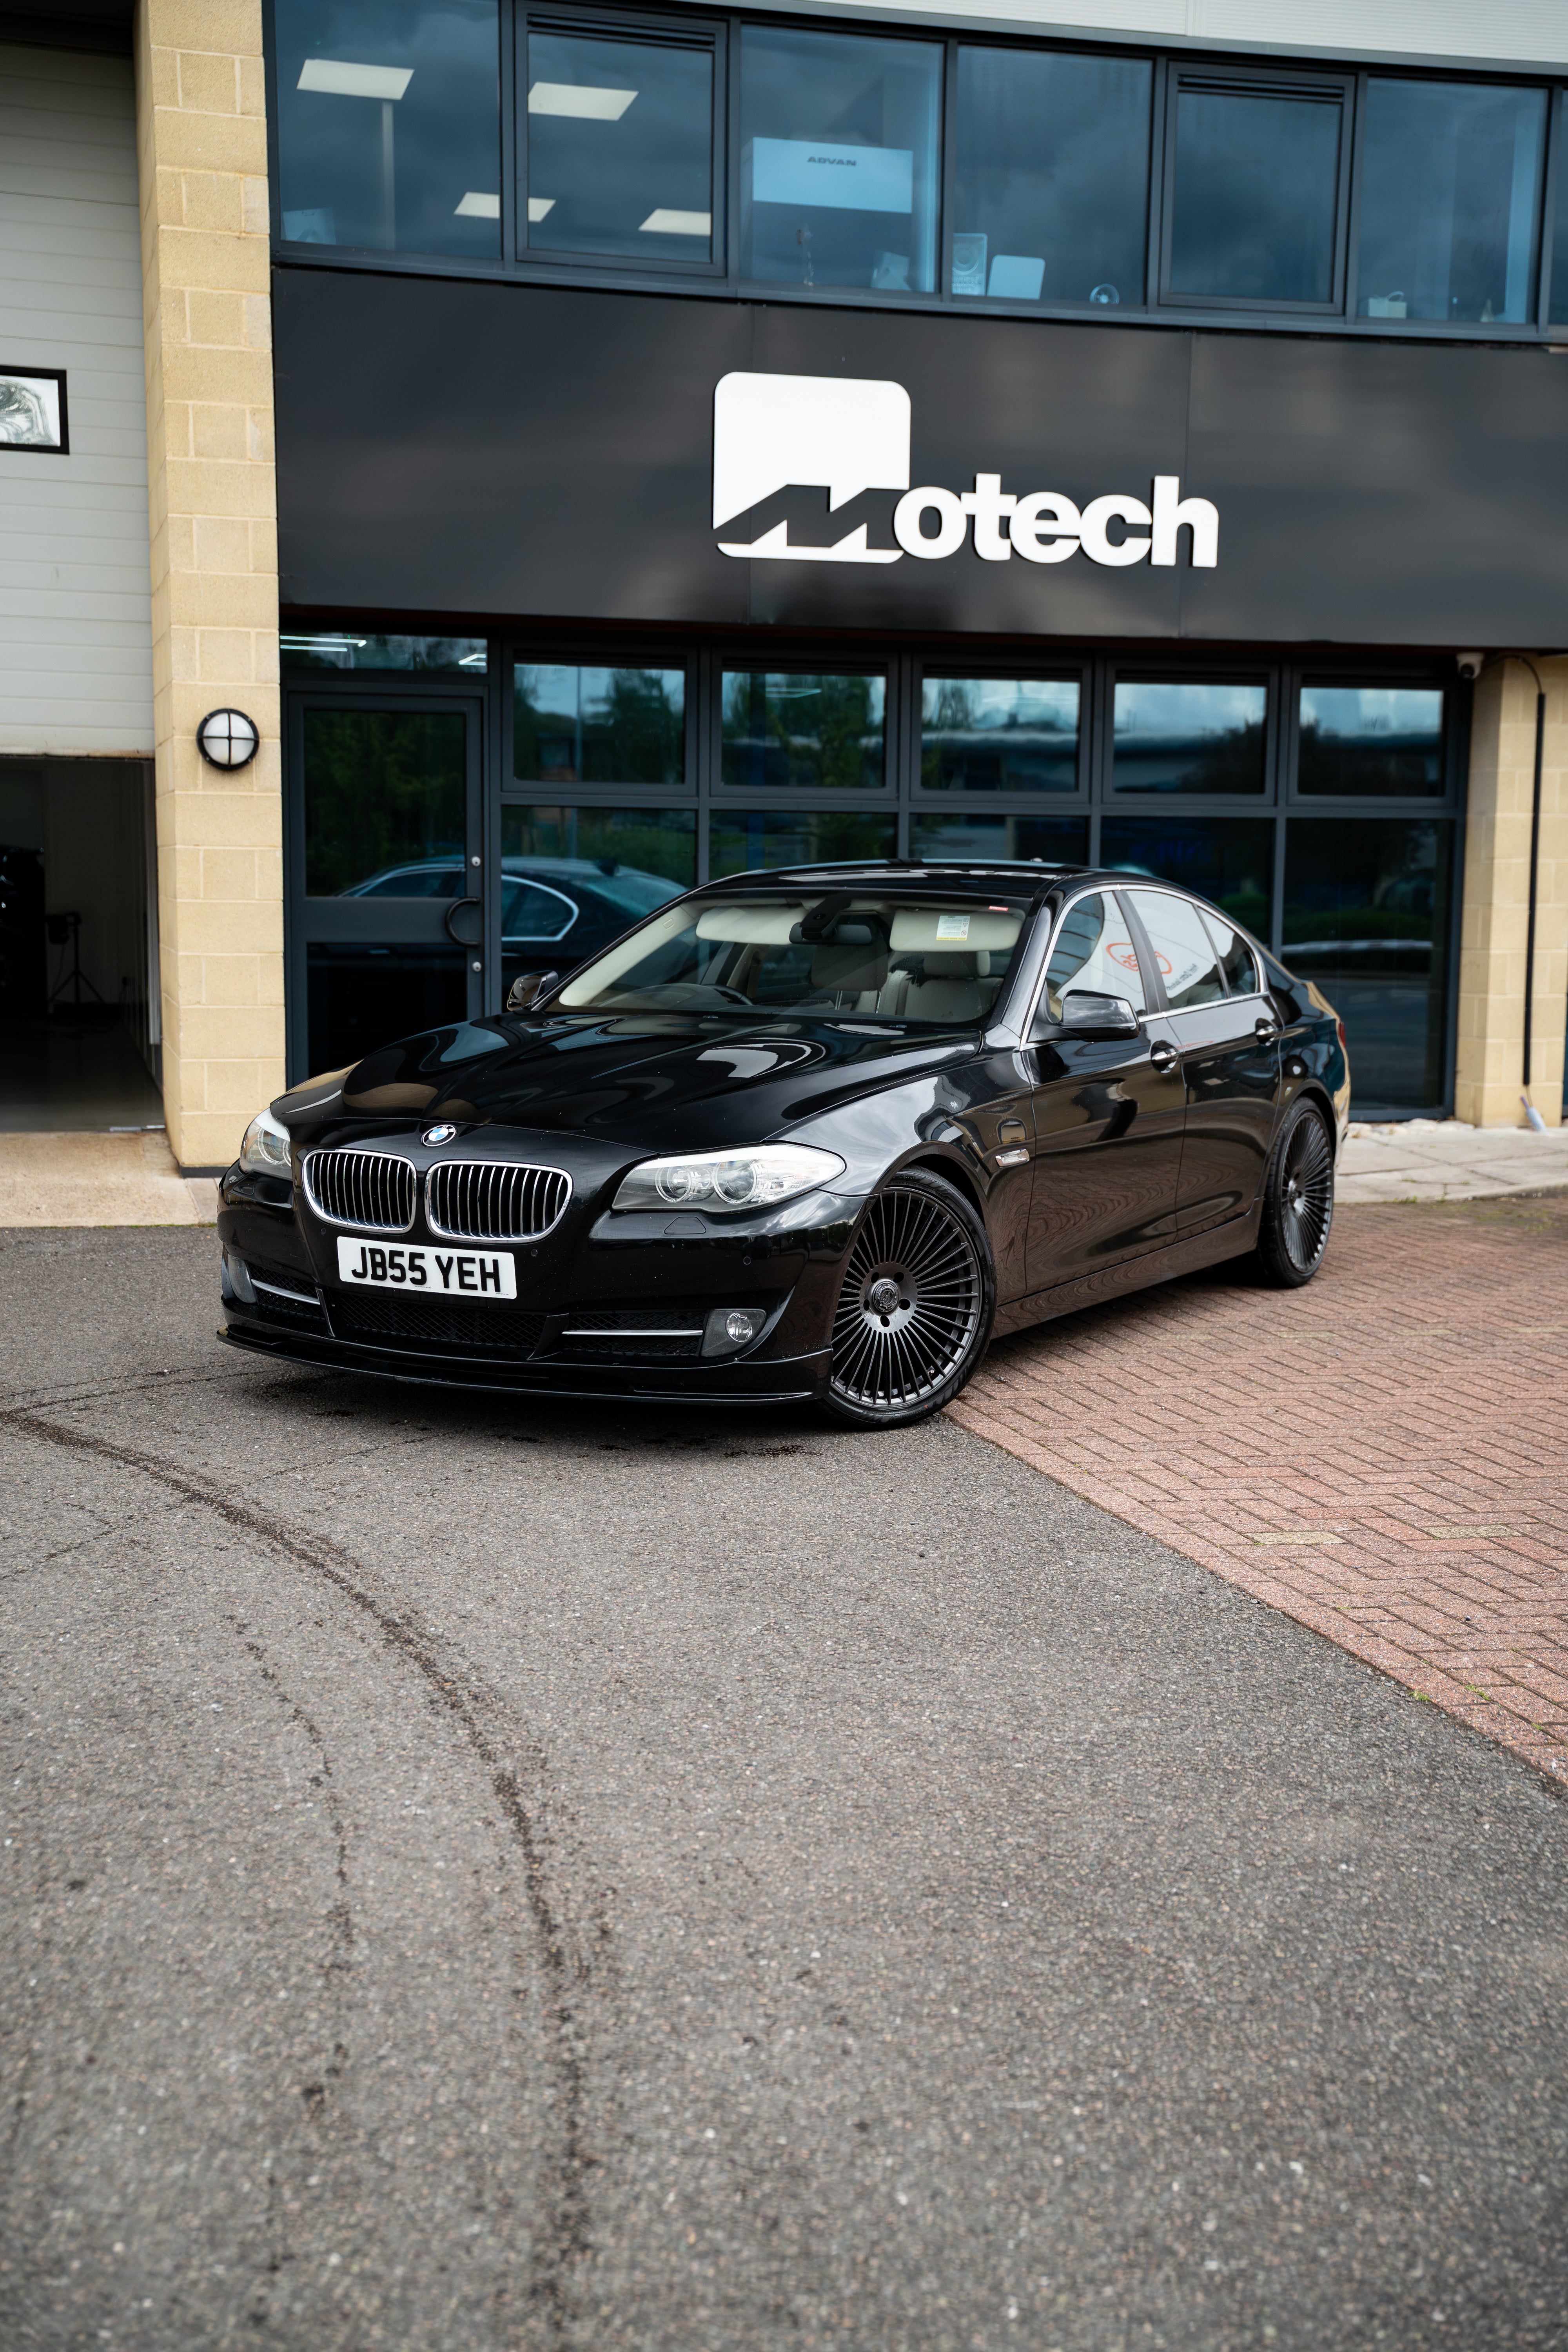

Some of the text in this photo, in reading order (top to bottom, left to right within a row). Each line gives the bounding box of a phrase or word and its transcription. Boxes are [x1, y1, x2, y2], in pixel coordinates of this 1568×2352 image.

[807, 156, 857, 167] ADVAN
[351, 1247, 501, 1292] JB55 YEH
